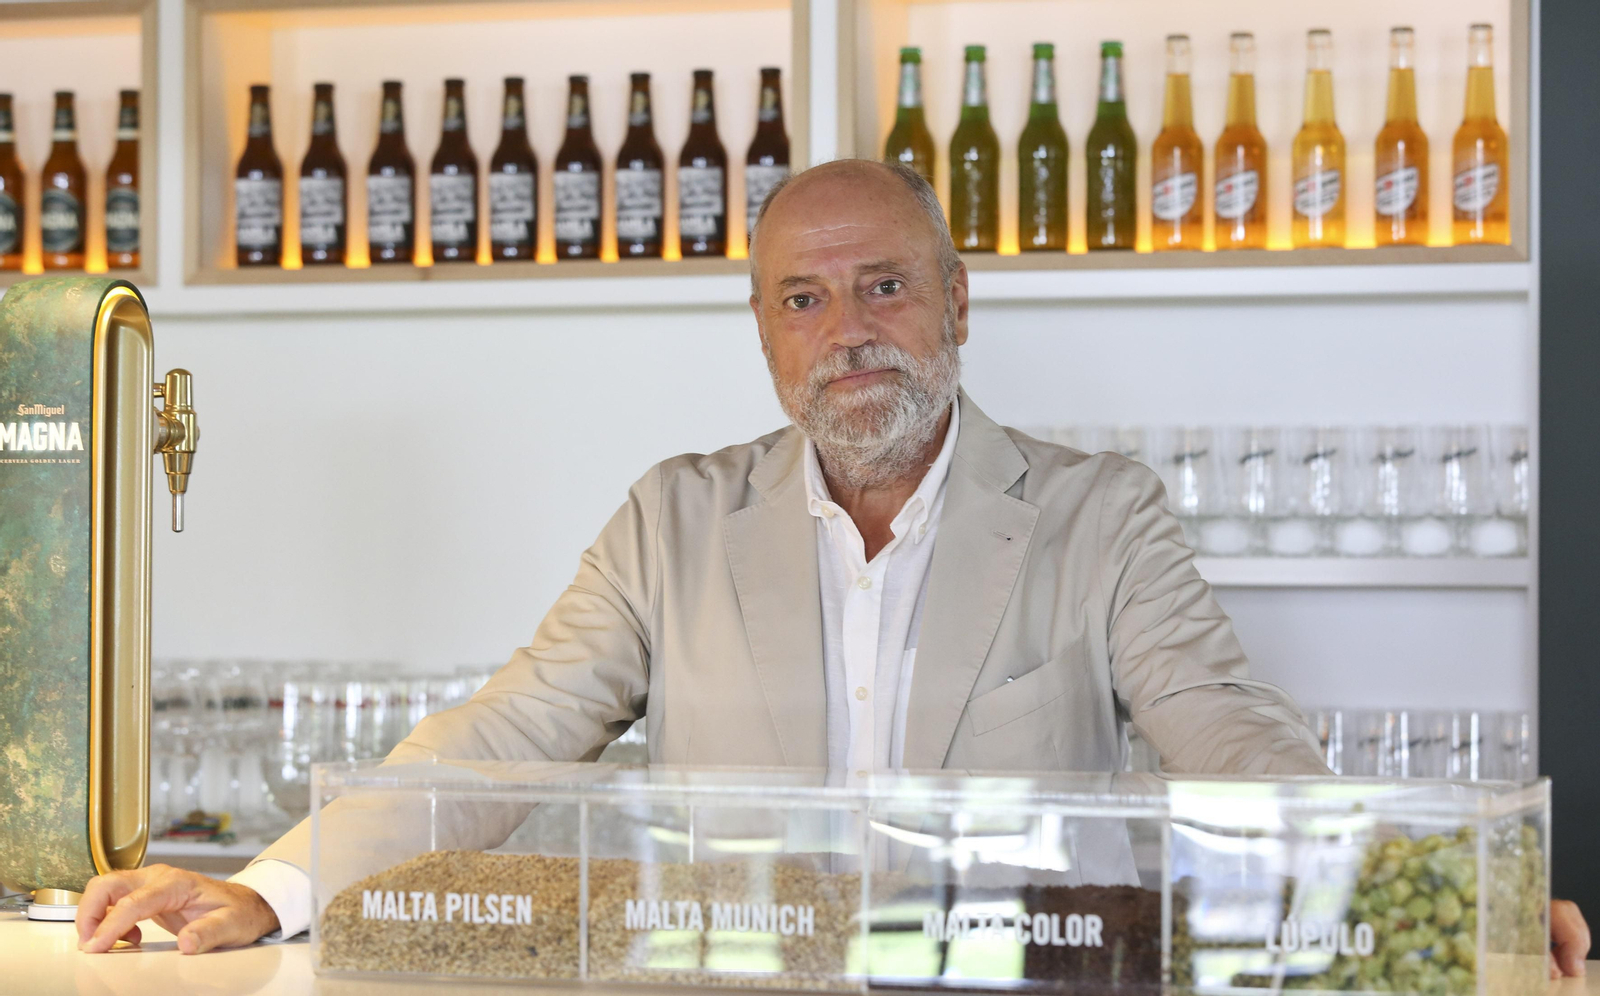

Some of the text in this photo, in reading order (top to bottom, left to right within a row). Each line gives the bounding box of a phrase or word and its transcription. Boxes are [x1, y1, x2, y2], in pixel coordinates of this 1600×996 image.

[0, 422, 84, 451] MAGNA
[362, 890, 532, 925] MALTA PILSEN
[625, 899, 815, 937] MALTA MUNICH
[922, 909, 1104, 947] MALTA COLOR
[1264, 913, 1375, 957] LÚPULO
